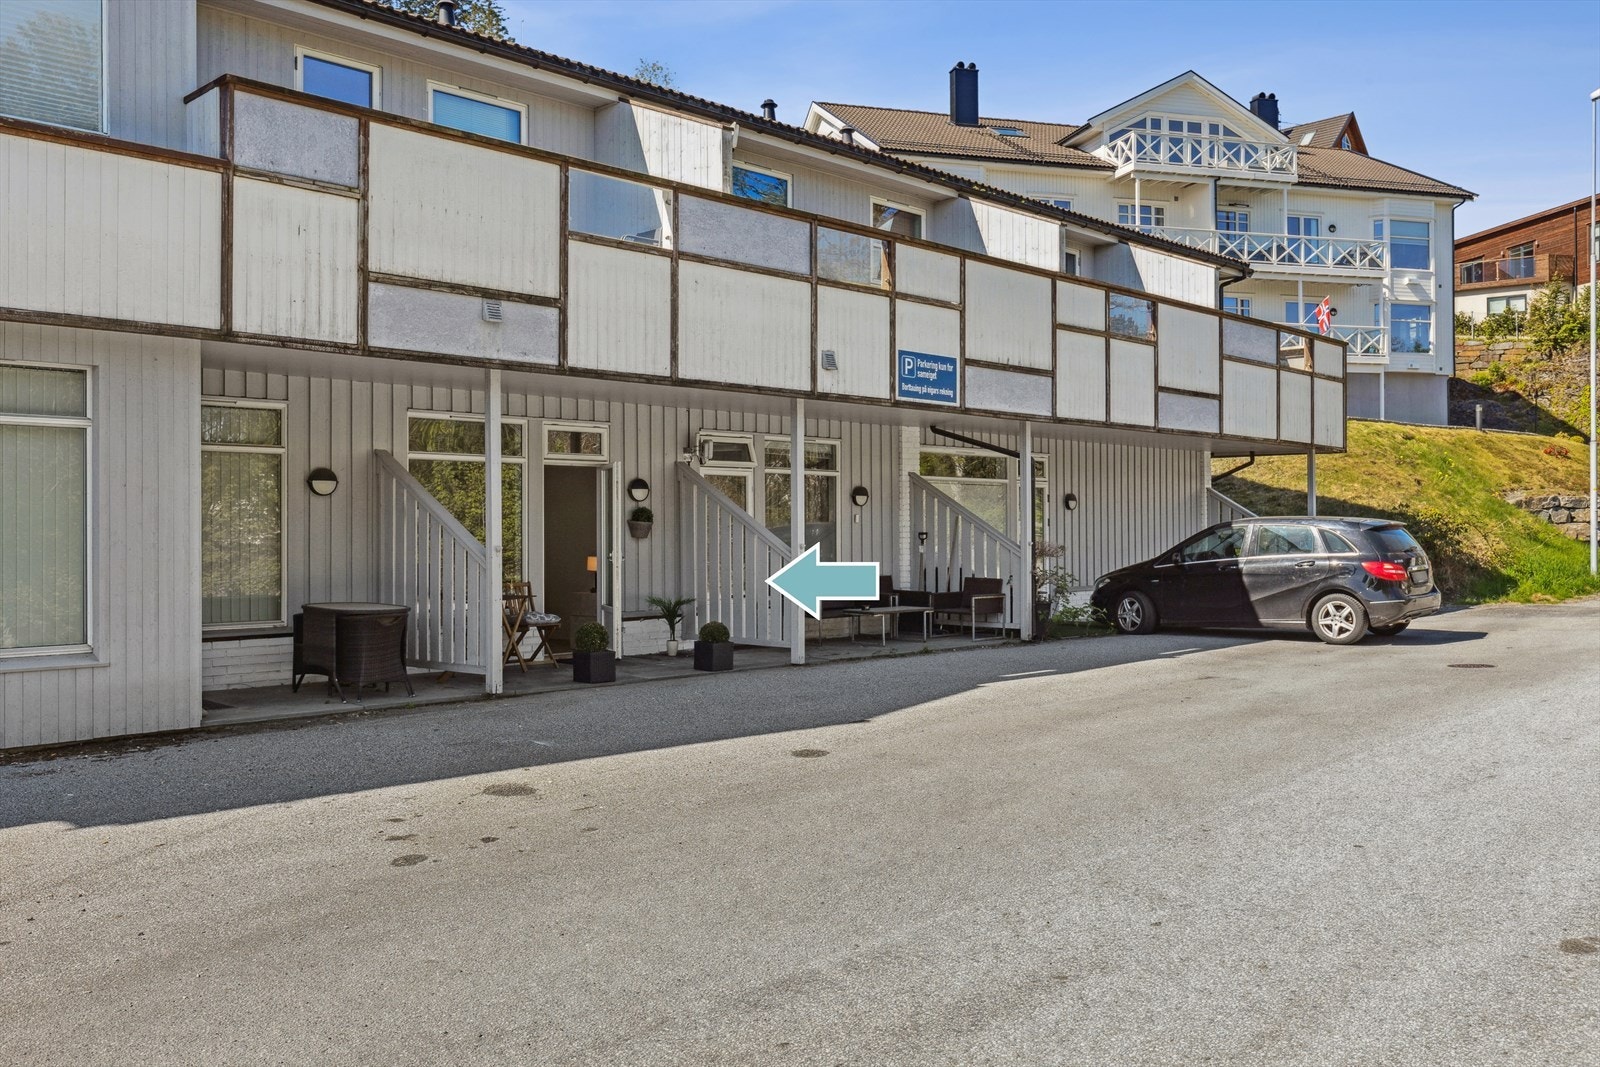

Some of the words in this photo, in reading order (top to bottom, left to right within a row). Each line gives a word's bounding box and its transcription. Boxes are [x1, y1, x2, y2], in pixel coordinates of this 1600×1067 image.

[905, 358, 914, 375] P
[917, 359, 938, 371] Parkering
[938, 362, 947, 371] kun
[917, 370, 937, 381] sameiget
[921, 385, 927, 394] på
